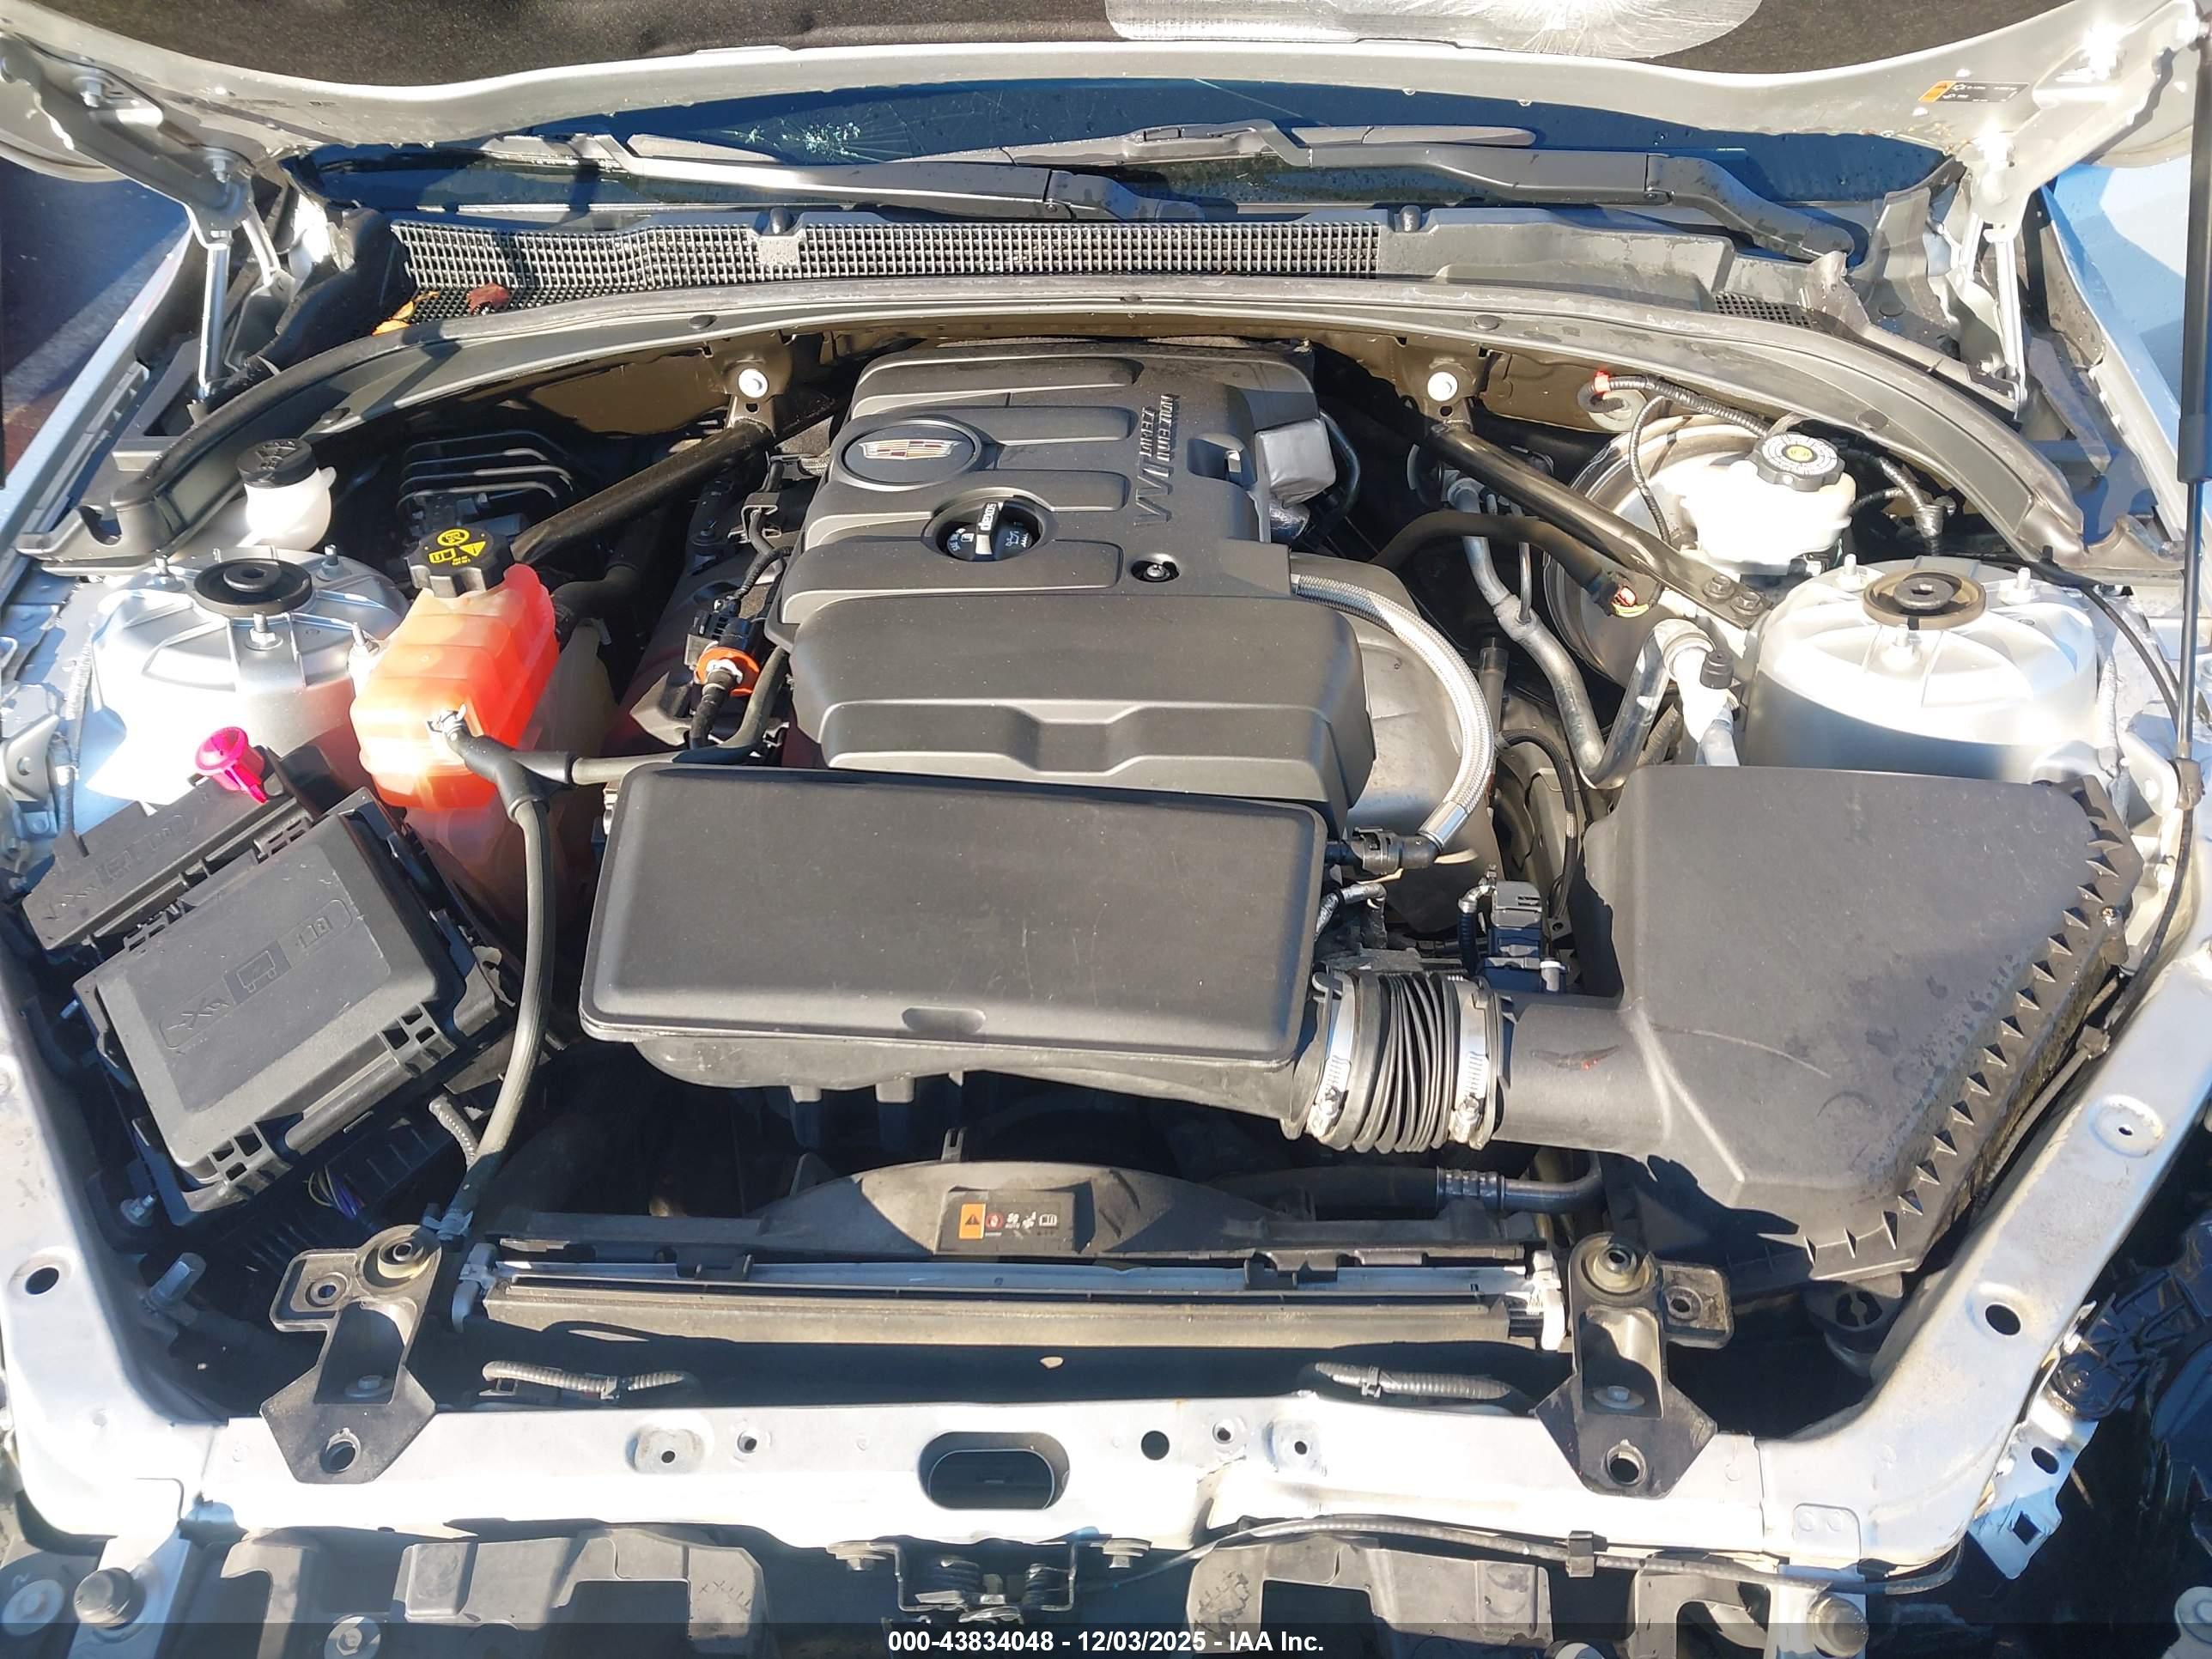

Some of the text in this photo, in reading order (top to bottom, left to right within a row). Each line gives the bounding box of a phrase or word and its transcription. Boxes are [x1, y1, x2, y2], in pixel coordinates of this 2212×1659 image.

[1139, 406, 1156, 458] DIRECT
[1157, 395, 1174, 462] INJECTION
[978, 502, 997, 531] dexos
[1133, 457, 1173, 526] VVT
